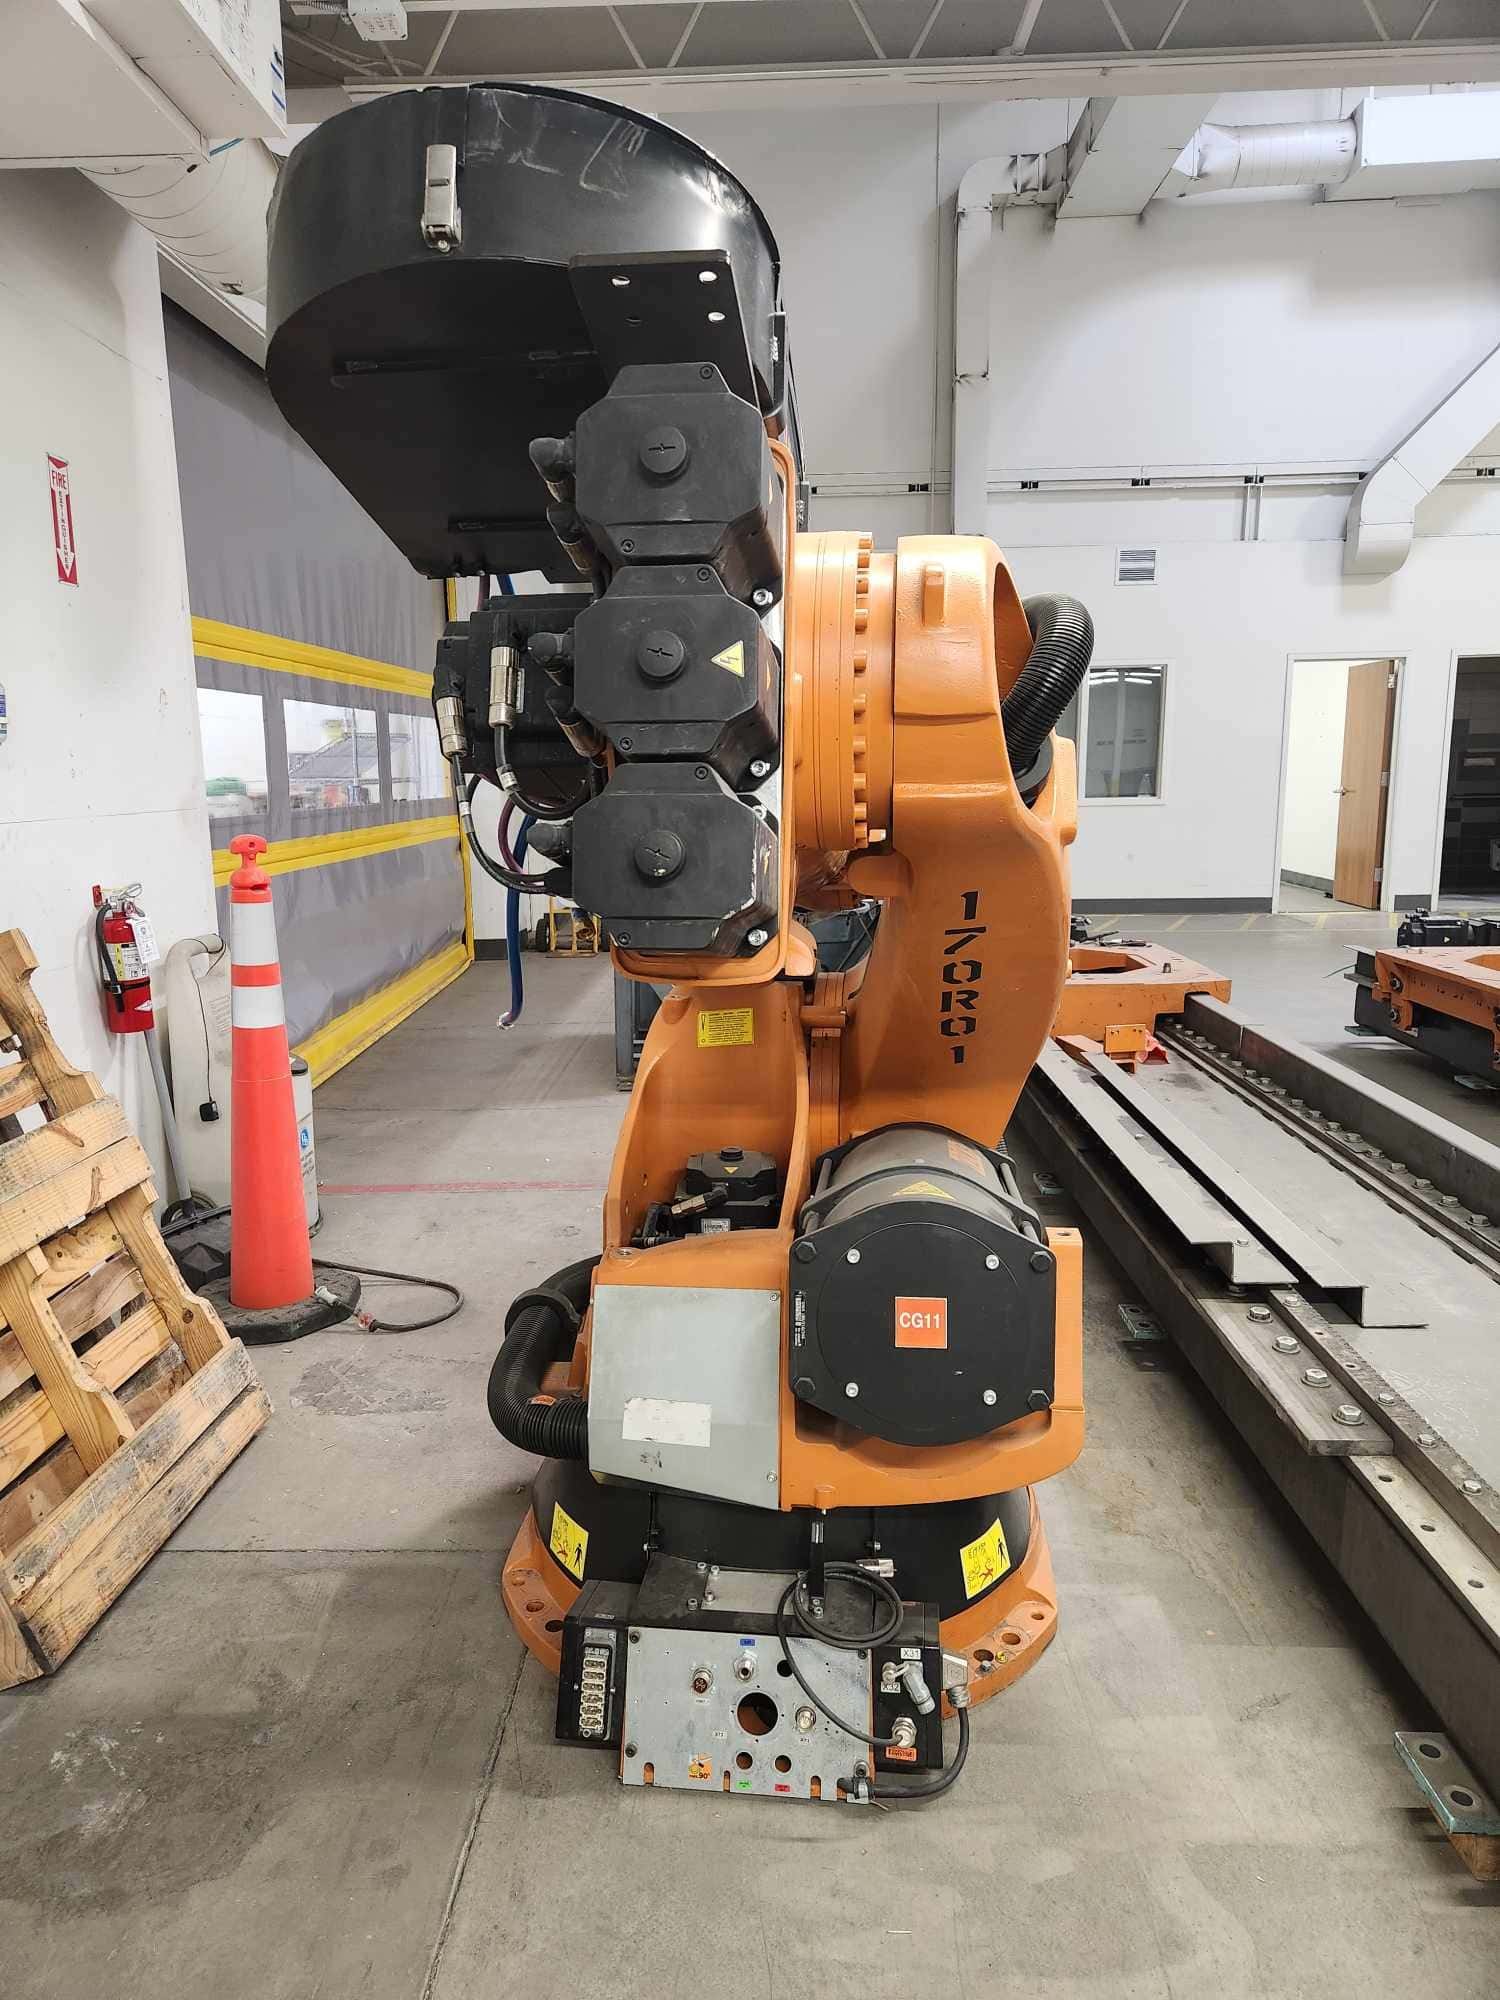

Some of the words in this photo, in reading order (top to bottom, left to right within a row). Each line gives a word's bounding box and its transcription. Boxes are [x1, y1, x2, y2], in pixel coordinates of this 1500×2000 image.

[51, 469, 67, 490] FIRE
[899, 1312, 940, 1329] CG11
[903, 1649, 919, 1658] X31
